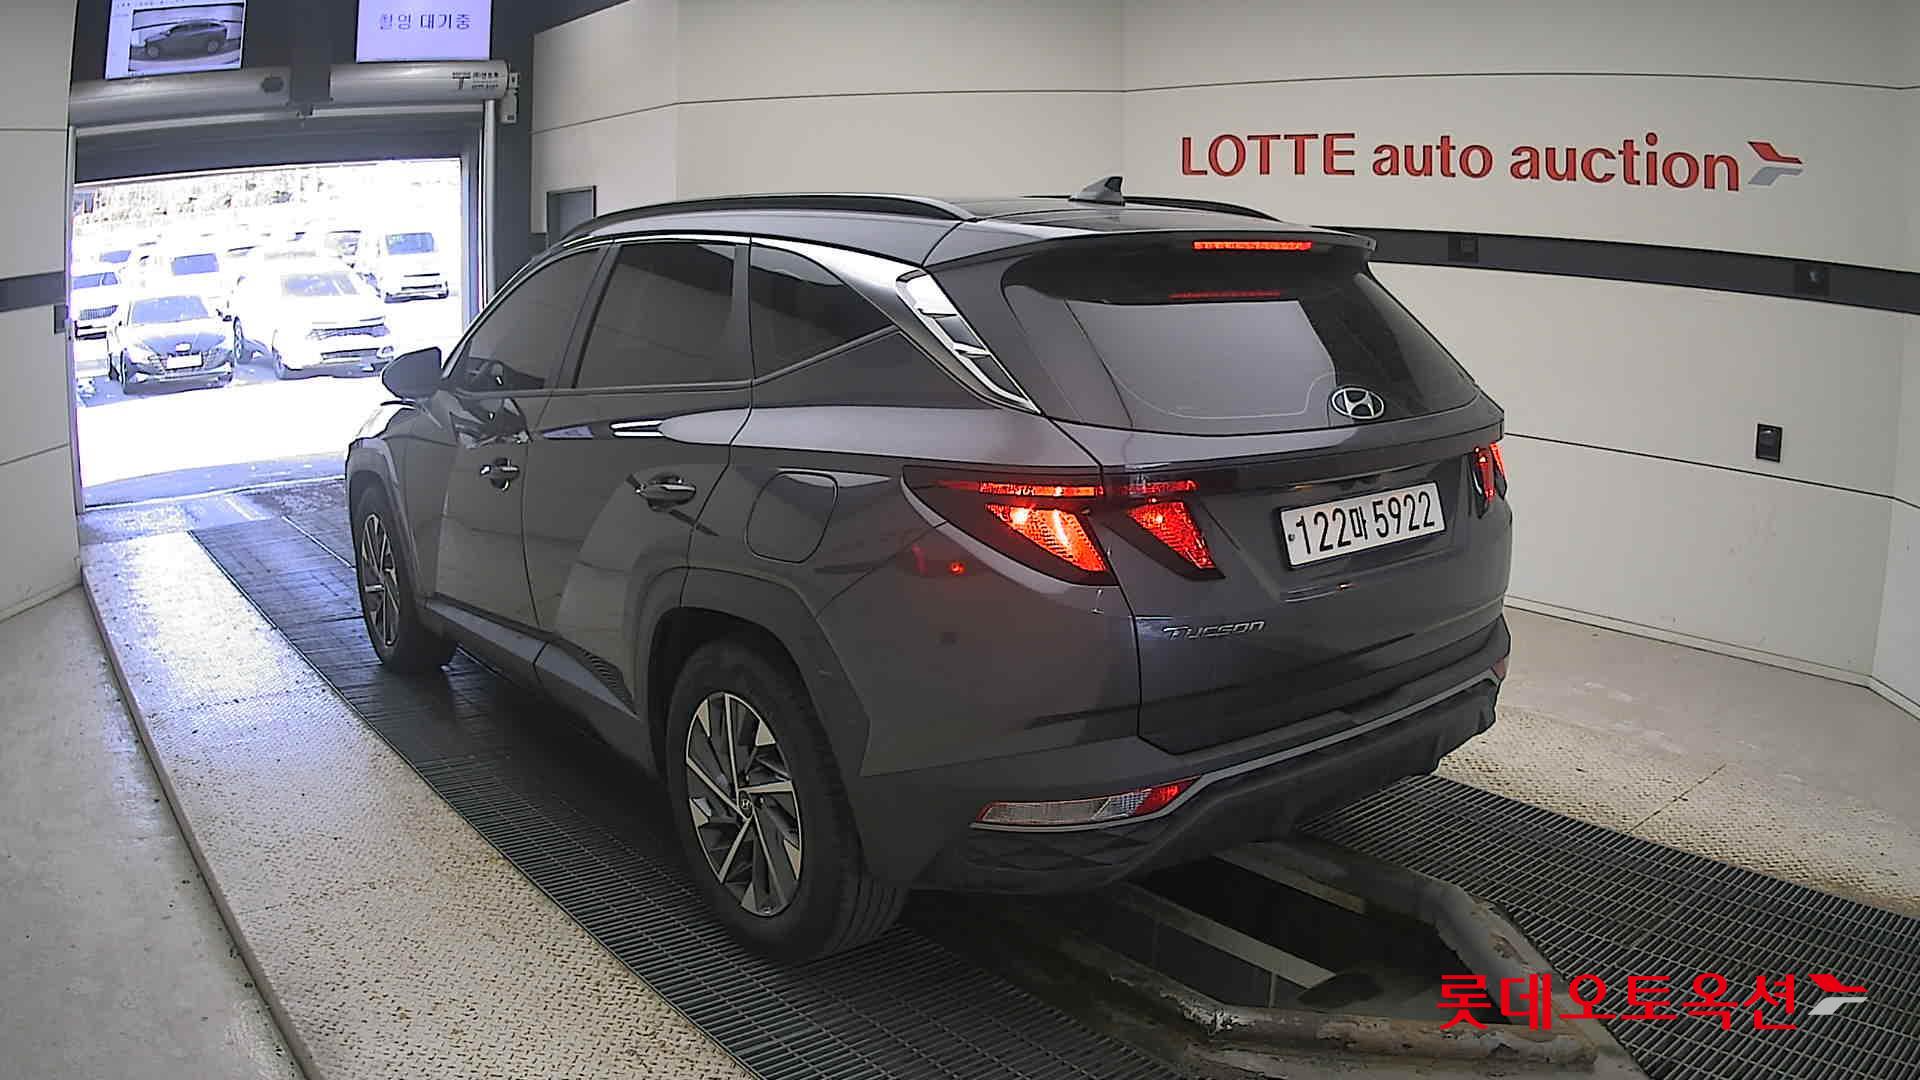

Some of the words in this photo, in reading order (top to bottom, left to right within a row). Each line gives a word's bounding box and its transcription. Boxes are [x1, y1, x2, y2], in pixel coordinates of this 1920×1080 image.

[420, 13, 472, 30] 대기중
[1182, 133, 1355, 176] LOTTE
[1373, 136, 1493, 178] auto
[1511, 133, 1739, 191] auction
[1296, 506, 1368, 554] 122마
[1373, 491, 1434, 538] 5922
